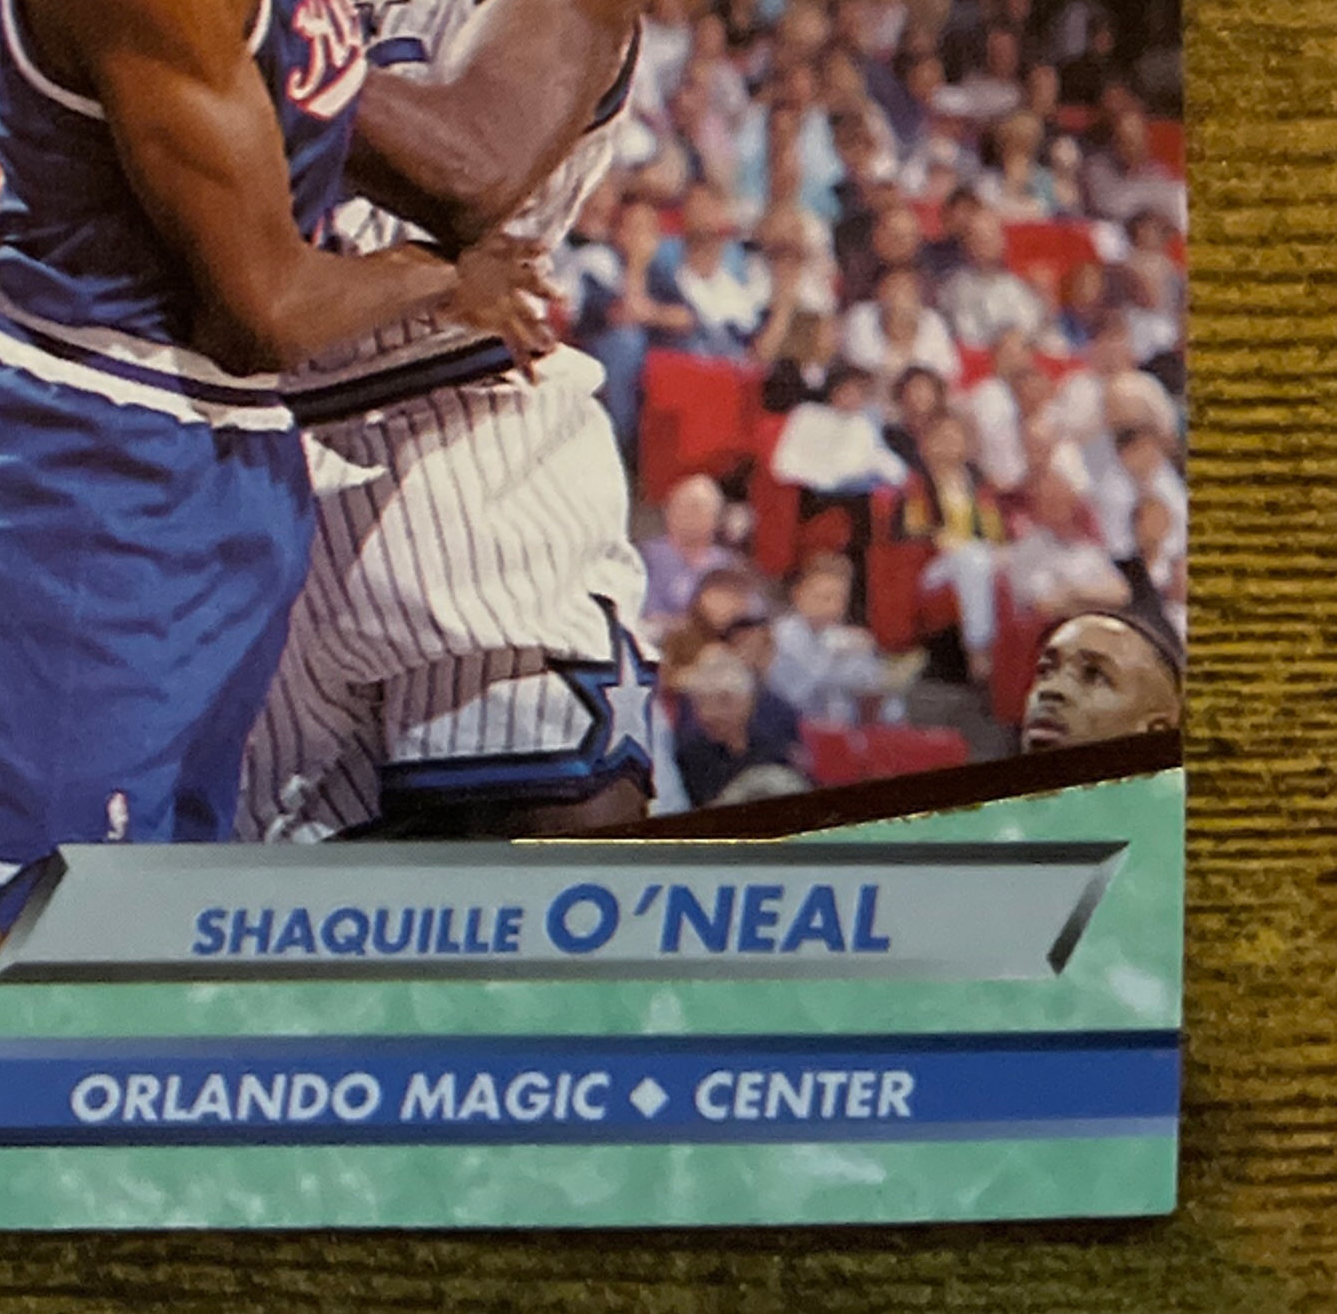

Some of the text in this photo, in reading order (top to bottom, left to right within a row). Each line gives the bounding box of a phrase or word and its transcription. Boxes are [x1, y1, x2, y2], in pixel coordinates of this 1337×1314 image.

[192, 883, 892, 958] SHAQUILLE O'NEAL
[70, 1068, 917, 1124] ORLANDO MAGIC CENTER
